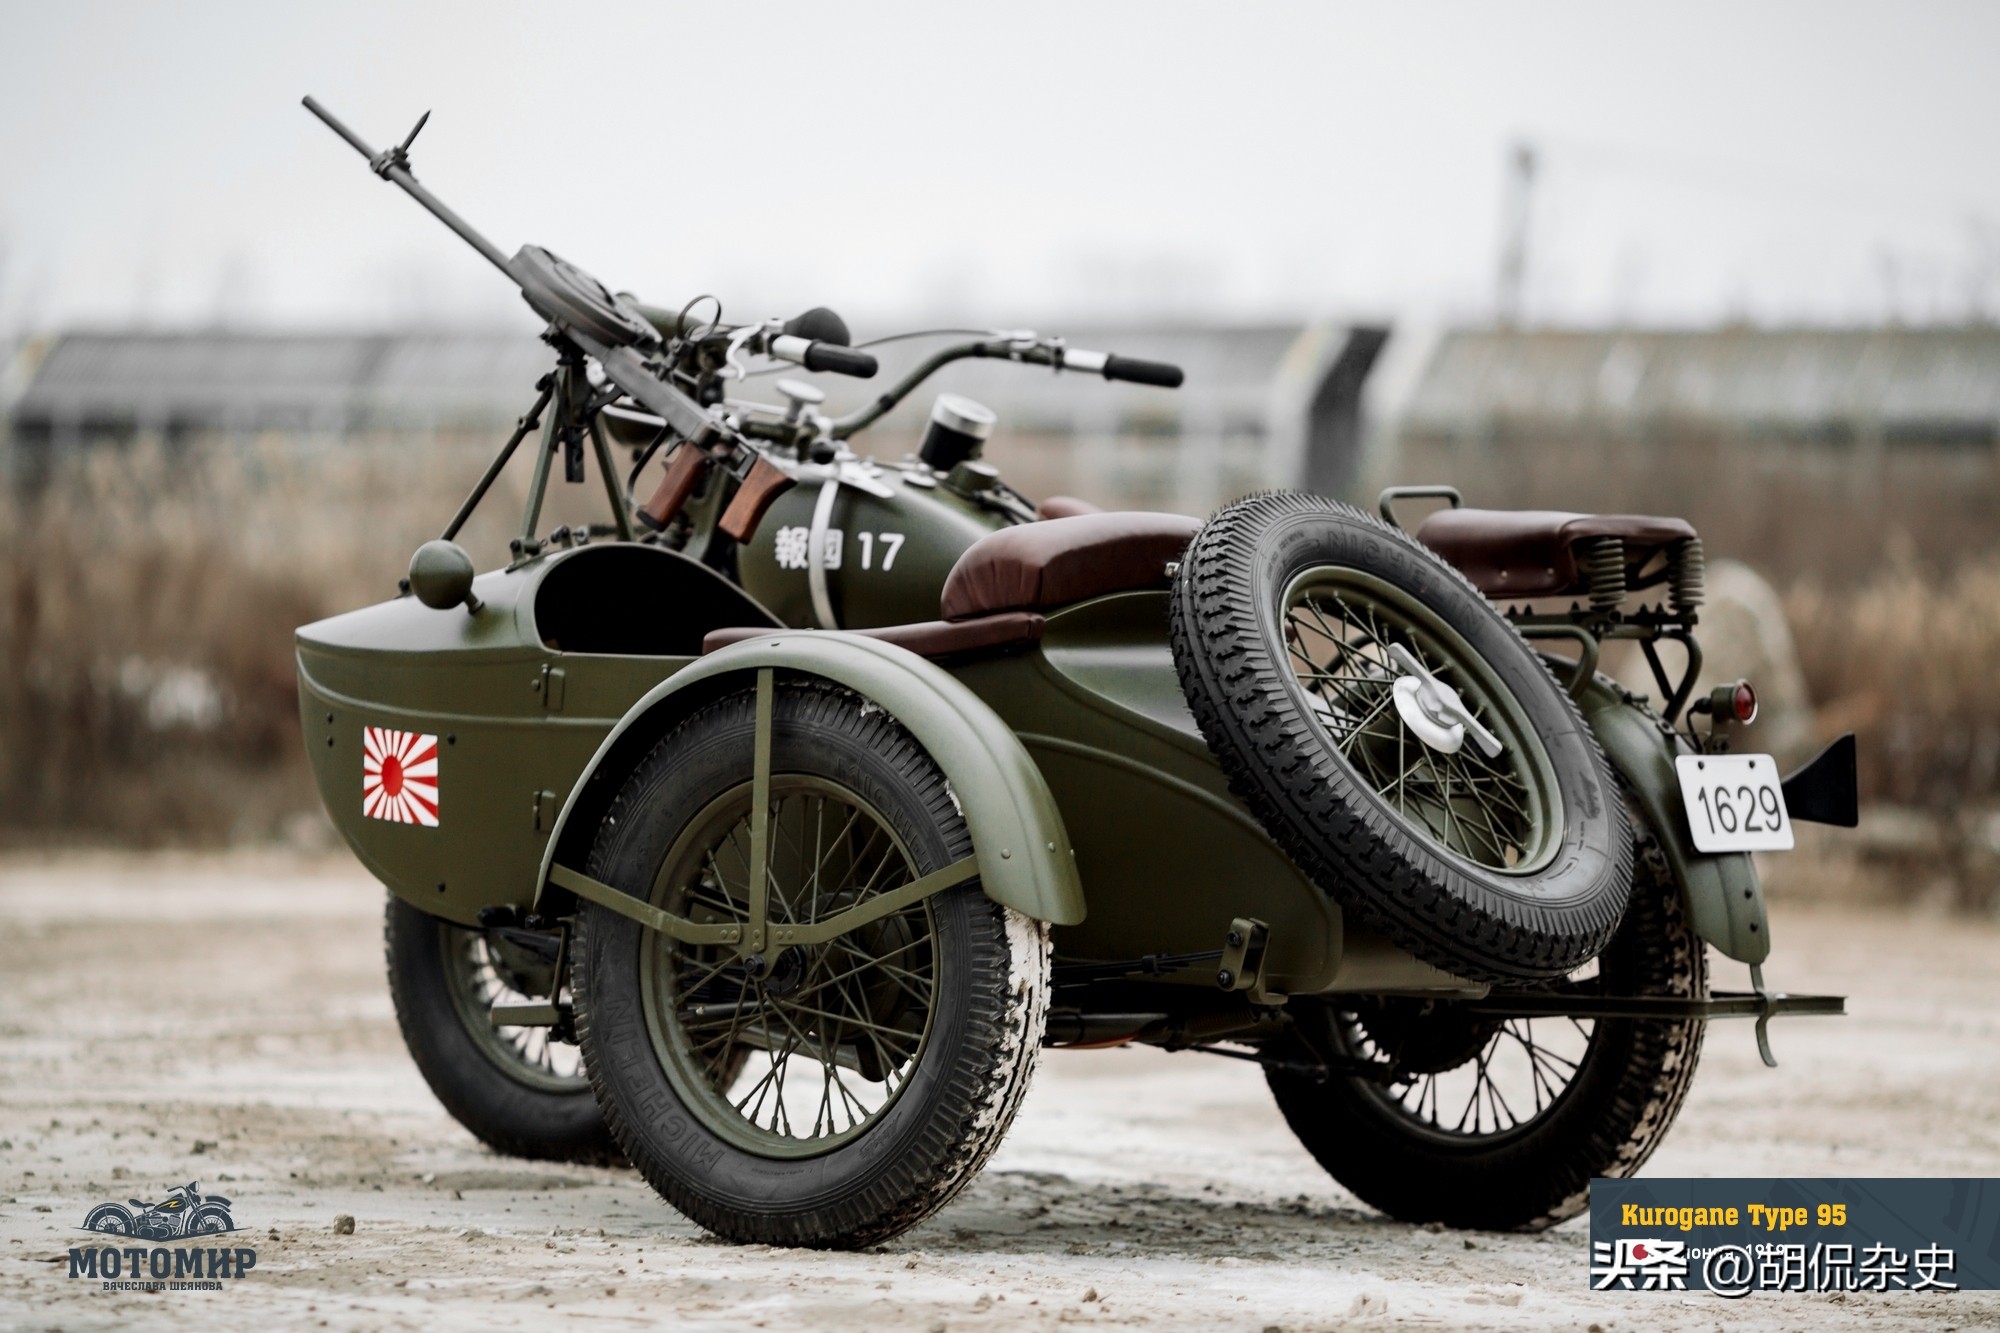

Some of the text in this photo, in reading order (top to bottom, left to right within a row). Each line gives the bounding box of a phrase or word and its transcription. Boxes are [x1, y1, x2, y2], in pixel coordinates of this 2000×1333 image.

[858, 531, 906, 571] 17
[1327, 529, 1485, 638] MICHELIN
[1698, 784, 1782, 835] 1629
[604, 997, 727, 1174] MICHELIN
